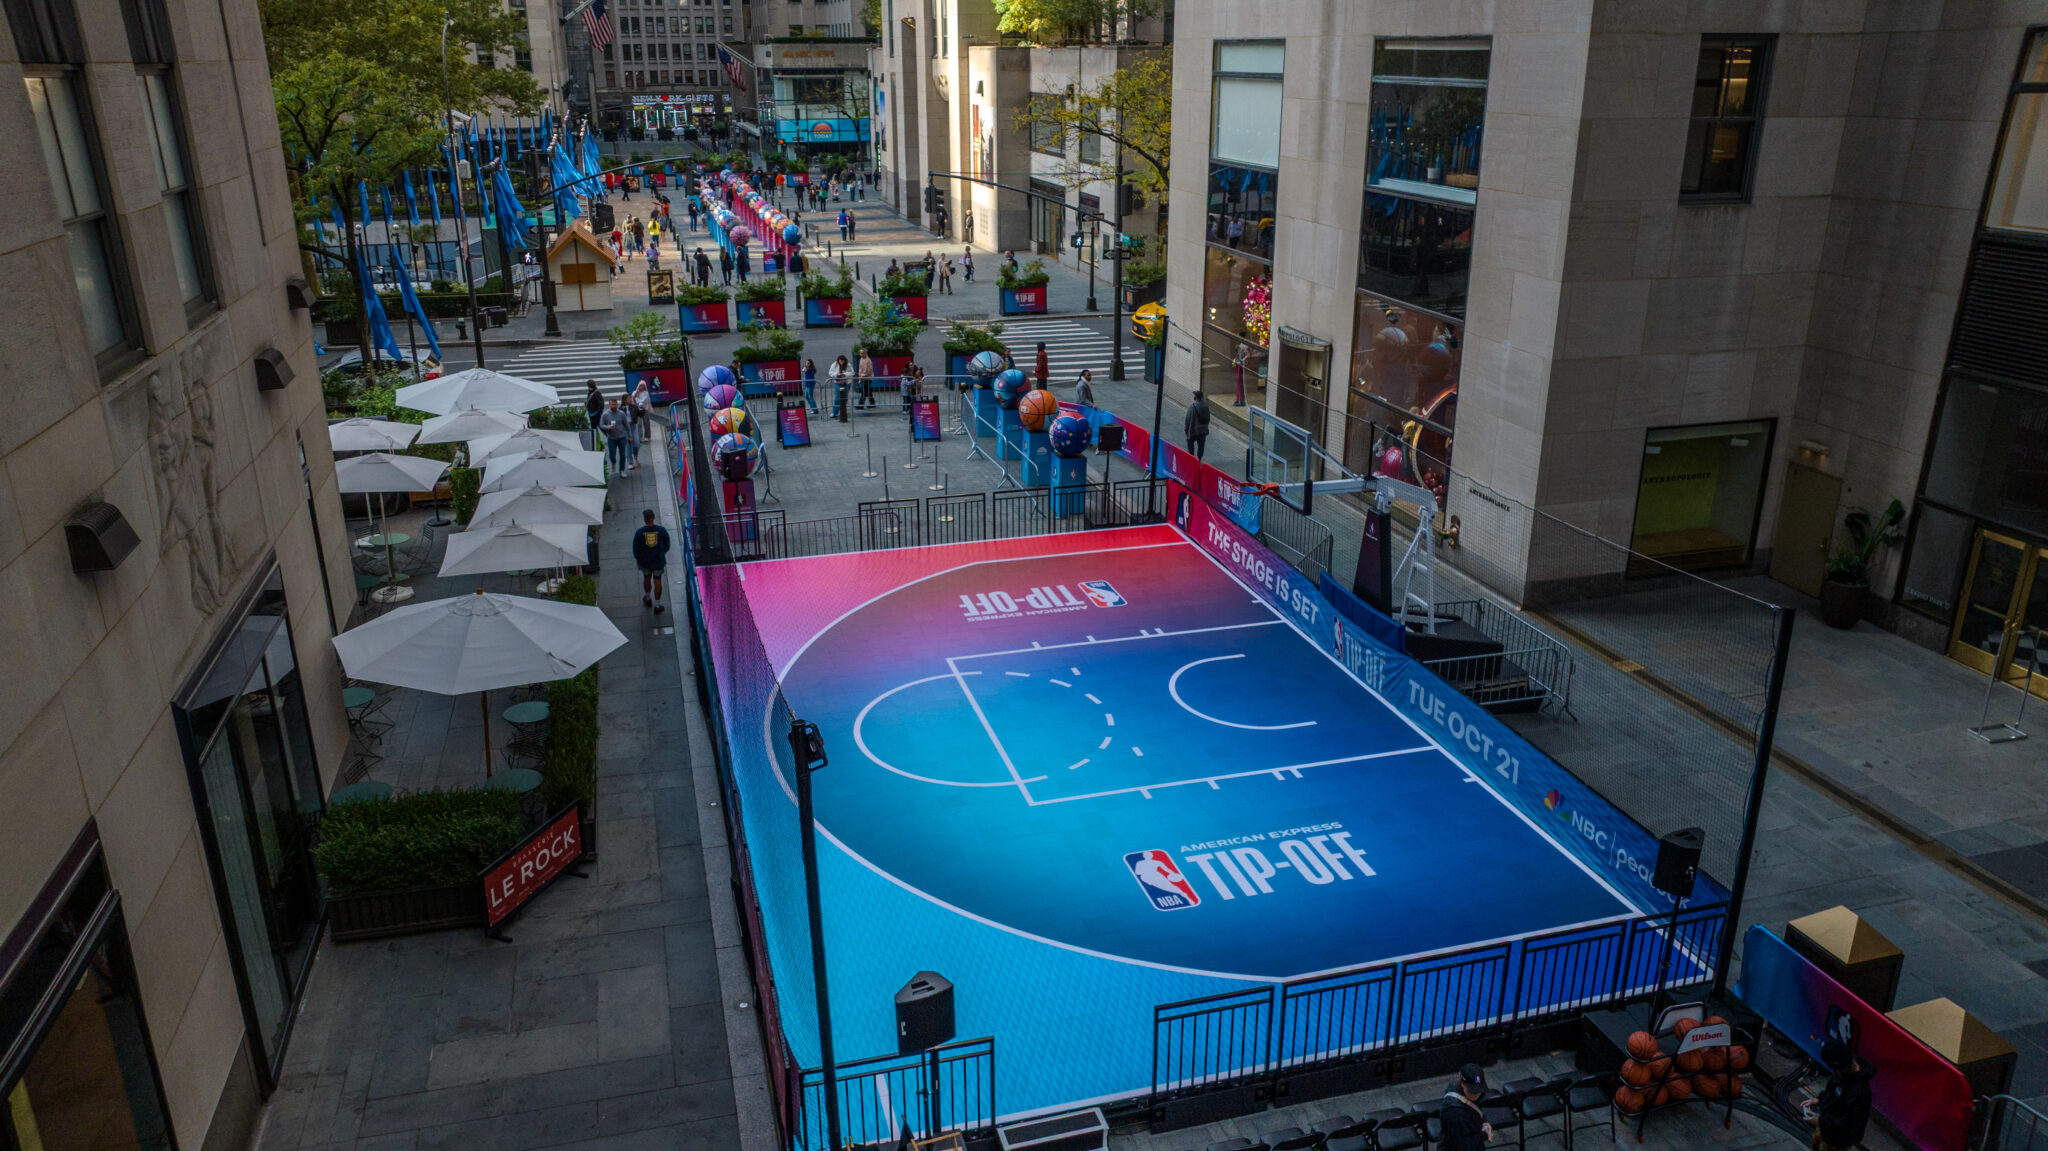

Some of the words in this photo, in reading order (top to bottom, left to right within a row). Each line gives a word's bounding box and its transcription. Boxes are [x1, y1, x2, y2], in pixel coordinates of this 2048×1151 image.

[632, 95, 654, 103] NEW
[1208, 522, 1230, 554] THE
[1231, 541, 1274, 590] STAGE
[1275, 575, 1290, 602] IS
[1292, 588, 1319, 625] SET
[959, 585, 1085, 617] TIP-OFF
[967, 611, 1023, 623] EXPRESS
[1026, 605, 1088, 616] AMERICAN
[1344, 631, 1386, 693] TIP-OFF
[1409, 678, 1445, 727] TUE
[1448, 711, 1494, 761] OCT
[1495, 748, 1520, 785] 21
[1180, 834, 1264, 853] AMERICAN
[1268, 821, 1343, 839] EXPRESS
[1571, 810, 1607, 850] NBC
[491, 873, 514, 908] LE
[521, 825, 575, 885] ROCK
[1185, 831, 1377, 901] TIP-OFF
[1157, 894, 1183, 908] NBA
[1692, 1032, 1722, 1042] Wilson
